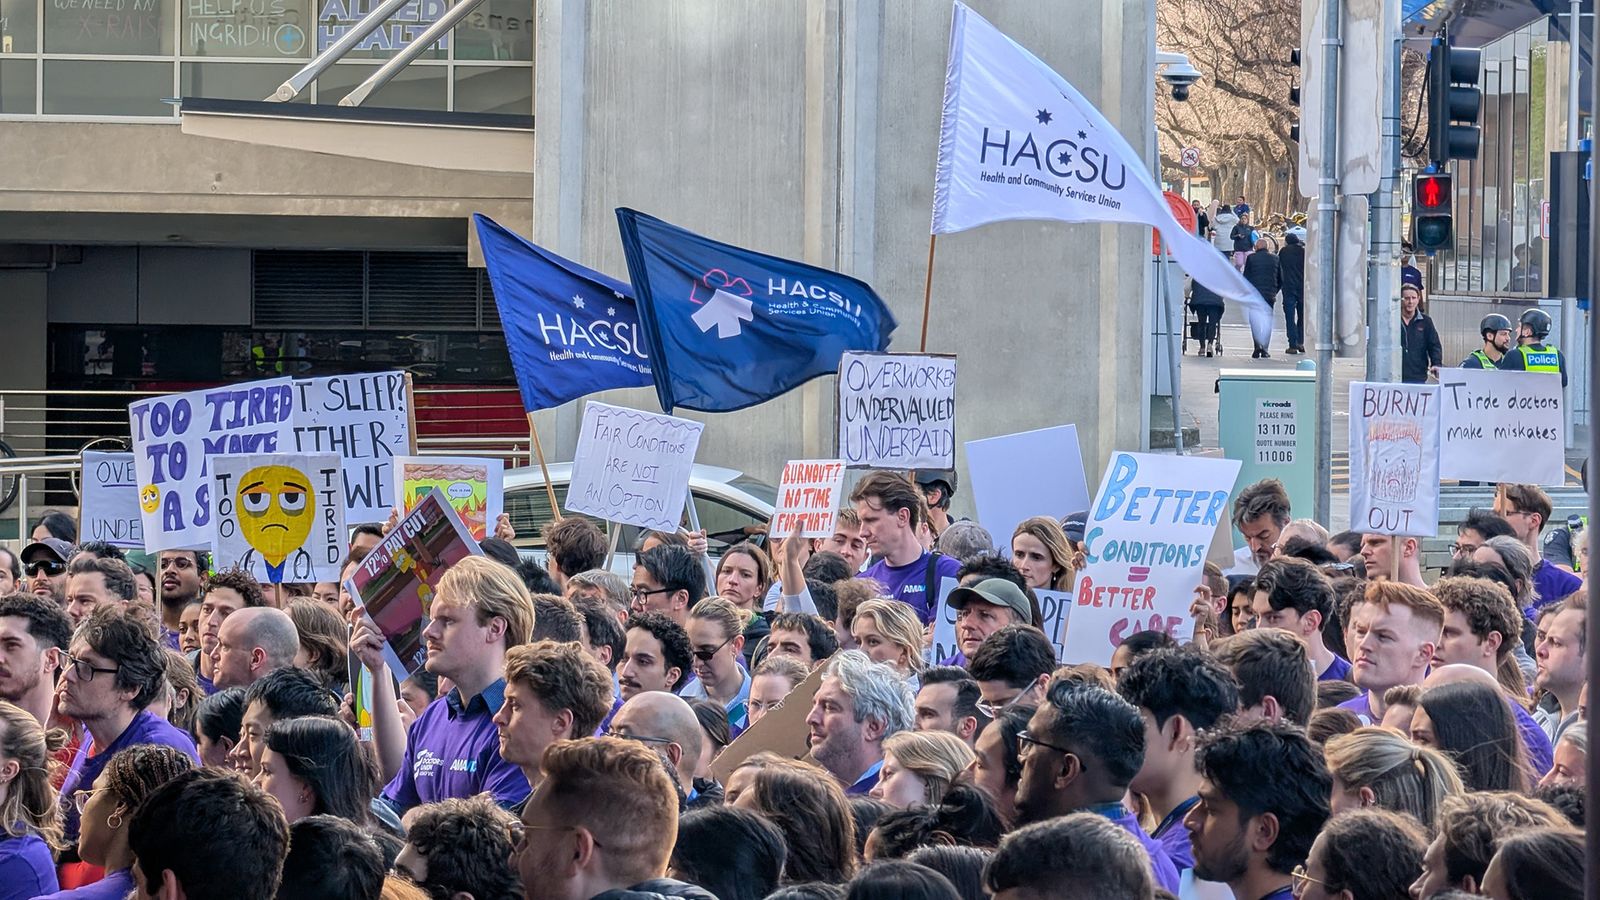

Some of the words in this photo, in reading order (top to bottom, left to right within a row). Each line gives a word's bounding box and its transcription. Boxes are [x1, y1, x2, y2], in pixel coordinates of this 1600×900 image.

[188, 0, 241, 15] HELP
[250, 0, 285, 14] US
[190, 22, 271, 47] INGRID!!
[980, 127, 1126, 191] HACSU
[980, 171, 1006, 184] Health
[1007, 173, 1022, 185] and
[1024, 174, 1065, 197] Community
[1066, 186, 1096, 203] Services
[1098, 194, 1121, 210] Union
[768, 301, 799, 310] Health
[809, 308, 836, 318] Union
[550, 349, 574, 361] Health
[575, 351, 587, 359] and
[1528, 354, 1556, 365] Police
[846, 360, 956, 391] OVERWORKED
[323, 373, 405, 412] SLEEP?
[1262, 400, 1292, 408] vicroads
[1363, 388, 1432, 417] BURNT
[1444, 382, 1500, 410] Tirde
[1507, 389, 1559, 410] doctors
[132, 398, 192, 441] TOO
[205, 384, 293, 432] TIRED
[846, 393, 954, 425] UNDERVALUED
[1259, 411, 1279, 419] PLEASE
[1281, 411, 1294, 419] RING
[594, 415, 621, 444] FAIR
[627, 423, 685, 454] CONDITIONS
[846, 425, 954, 462] UNDERPAID
[1258, 424, 1268, 435] 13
[1272, 424, 1280, 435] 11
[1284, 424, 1295, 435] 70
[1447, 423, 1483, 442] make
[1494, 421, 1557, 441] miskates
[146, 440, 188, 484] TO
[604, 457, 628, 473] ARE
[632, 463, 659, 479] NOT
[1260, 451, 1292, 462] 11006
[343, 463, 392, 508] WE
[783, 463, 841, 484] BURNOUT?
[585, 482, 603, 502] AN
[608, 484, 664, 512] OPTION
[784, 488, 801, 508] NO
[804, 488, 831, 508] TIME
[1094, 453, 1229, 526] BETTER
[163, 490, 186, 532] A
[216, 473, 234, 538] TOO
[320, 468, 340, 564] TIRED
[1368, 507, 1413, 531] OUT
[777, 513, 796, 533] FOR
[797, 511, 833, 532] THAT!
[365, 549, 389, 577] 12%
[383, 530, 406, 557] PAY
[402, 509, 427, 539] CUT
[1085, 527, 1204, 568] CONDITIONS
[1078, 576, 1156, 610] BETTER
